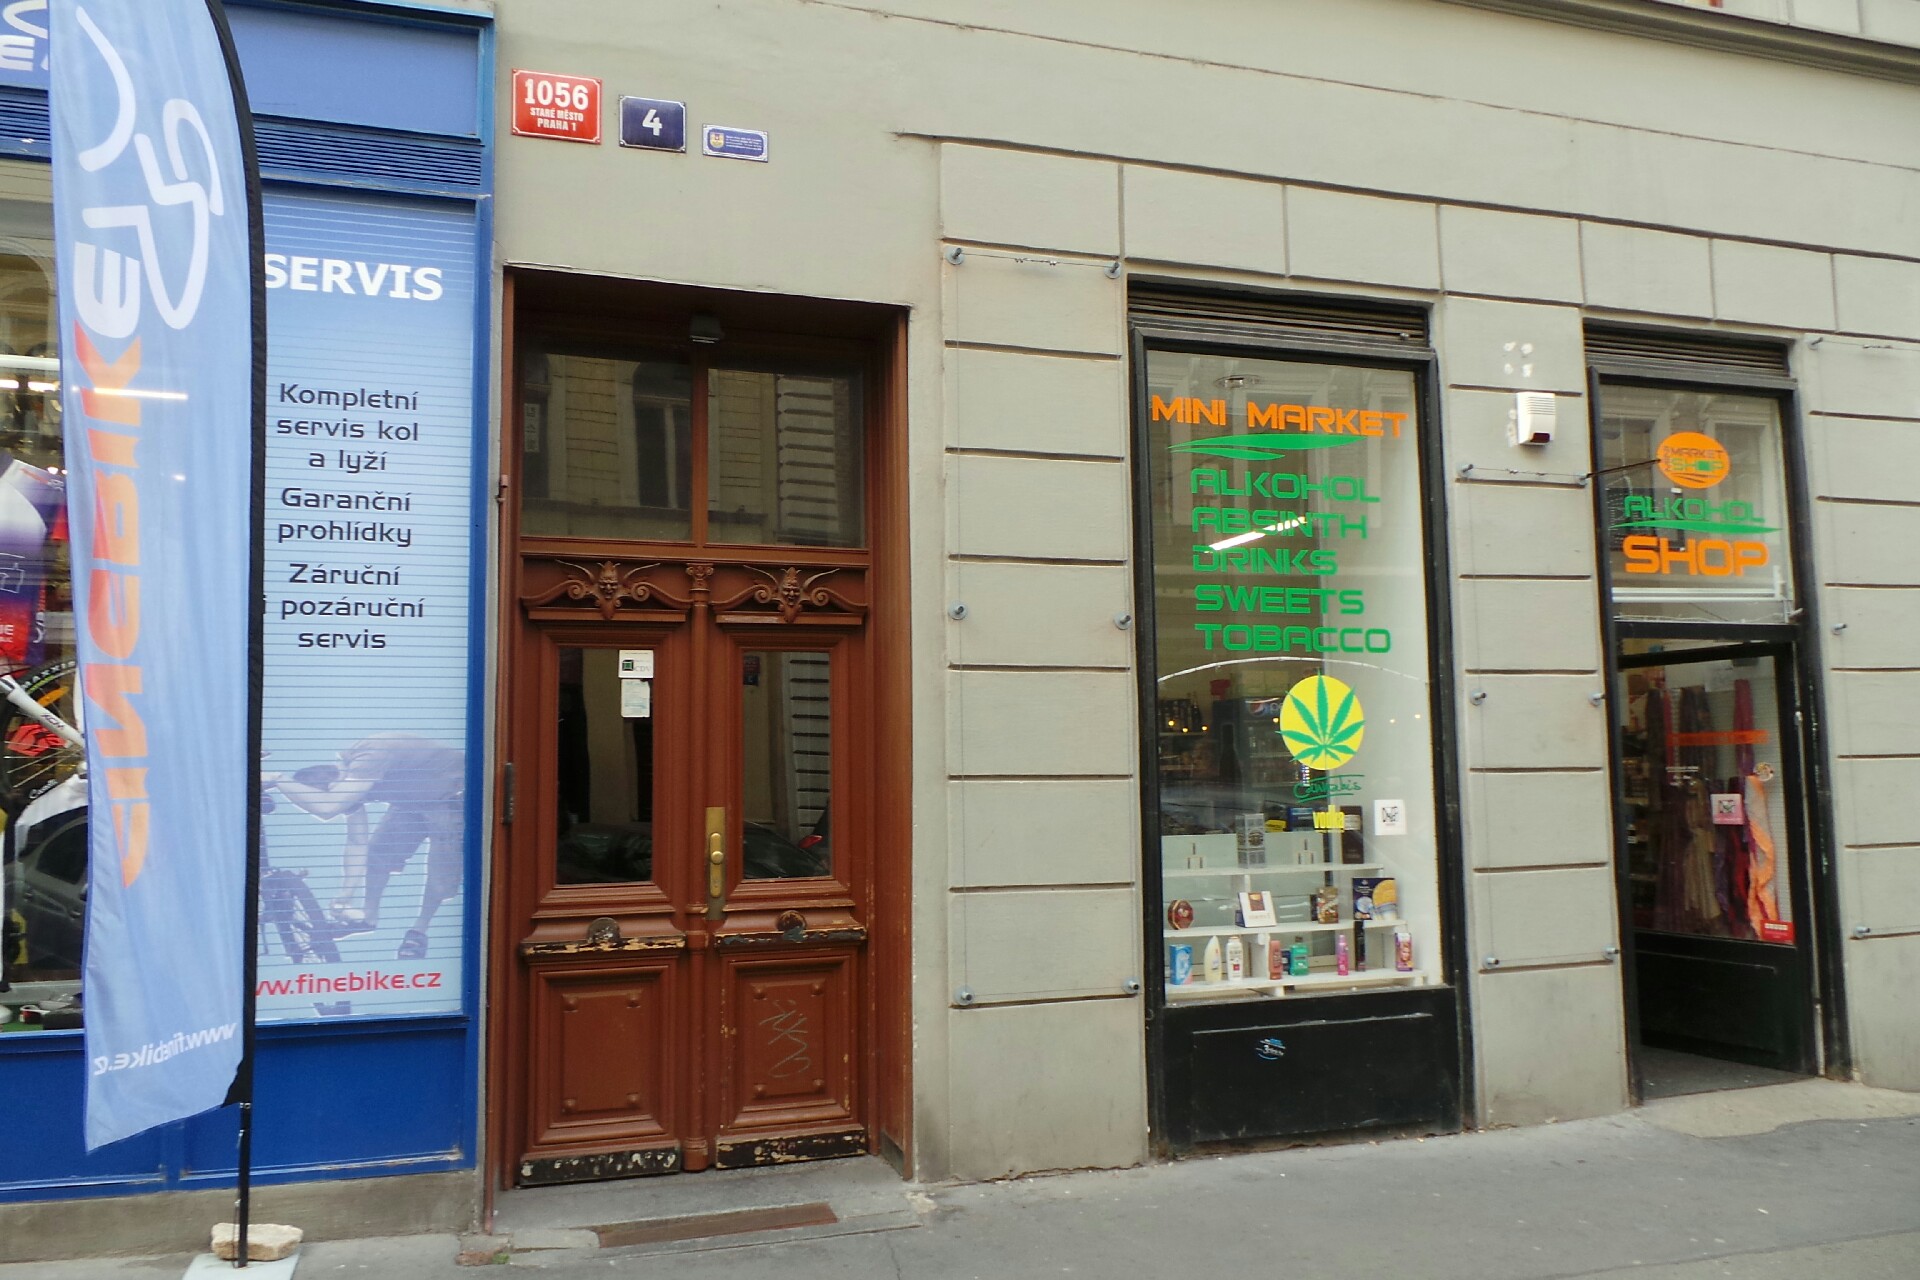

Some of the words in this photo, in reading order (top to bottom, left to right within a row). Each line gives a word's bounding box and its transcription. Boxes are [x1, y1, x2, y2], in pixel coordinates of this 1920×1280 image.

[525, 78, 589, 110] 1056
[537, 118, 569, 130] PRAHA
[571, 122, 577, 131] 1
[642, 109, 663, 136] 4
[265, 253, 443, 301] SERVIS
[279, 383, 419, 411] Kompletní
[277, 418, 364, 438] servis
[378, 420, 419, 441] kol
[1151, 395, 1227, 426] MINI
[1247, 401, 1409, 438] MARKET
[309, 453, 325, 468] a
[339, 449, 388, 474] lyží
[281, 487, 412, 511] Garanční
[1190, 468, 1381, 503] ALKOHOL
[1191, 507, 1368, 540] ABSINTH
[1623, 495, 1766, 524] ALKOHOL
[278, 520, 411, 548] prohlídky
[1192, 545, 1338, 576] DRINKS
[1622, 534, 1769, 576] SHOP
[289, 563, 401, 586] Záruční
[281, 596, 425, 620] pozáruční
[1194, 584, 1365, 615] SWEETS
[298, 628, 386, 649] servis
[1194, 623, 1391, 653] TOBACCO
[255, 970, 442, 996] w.finebike.cz
